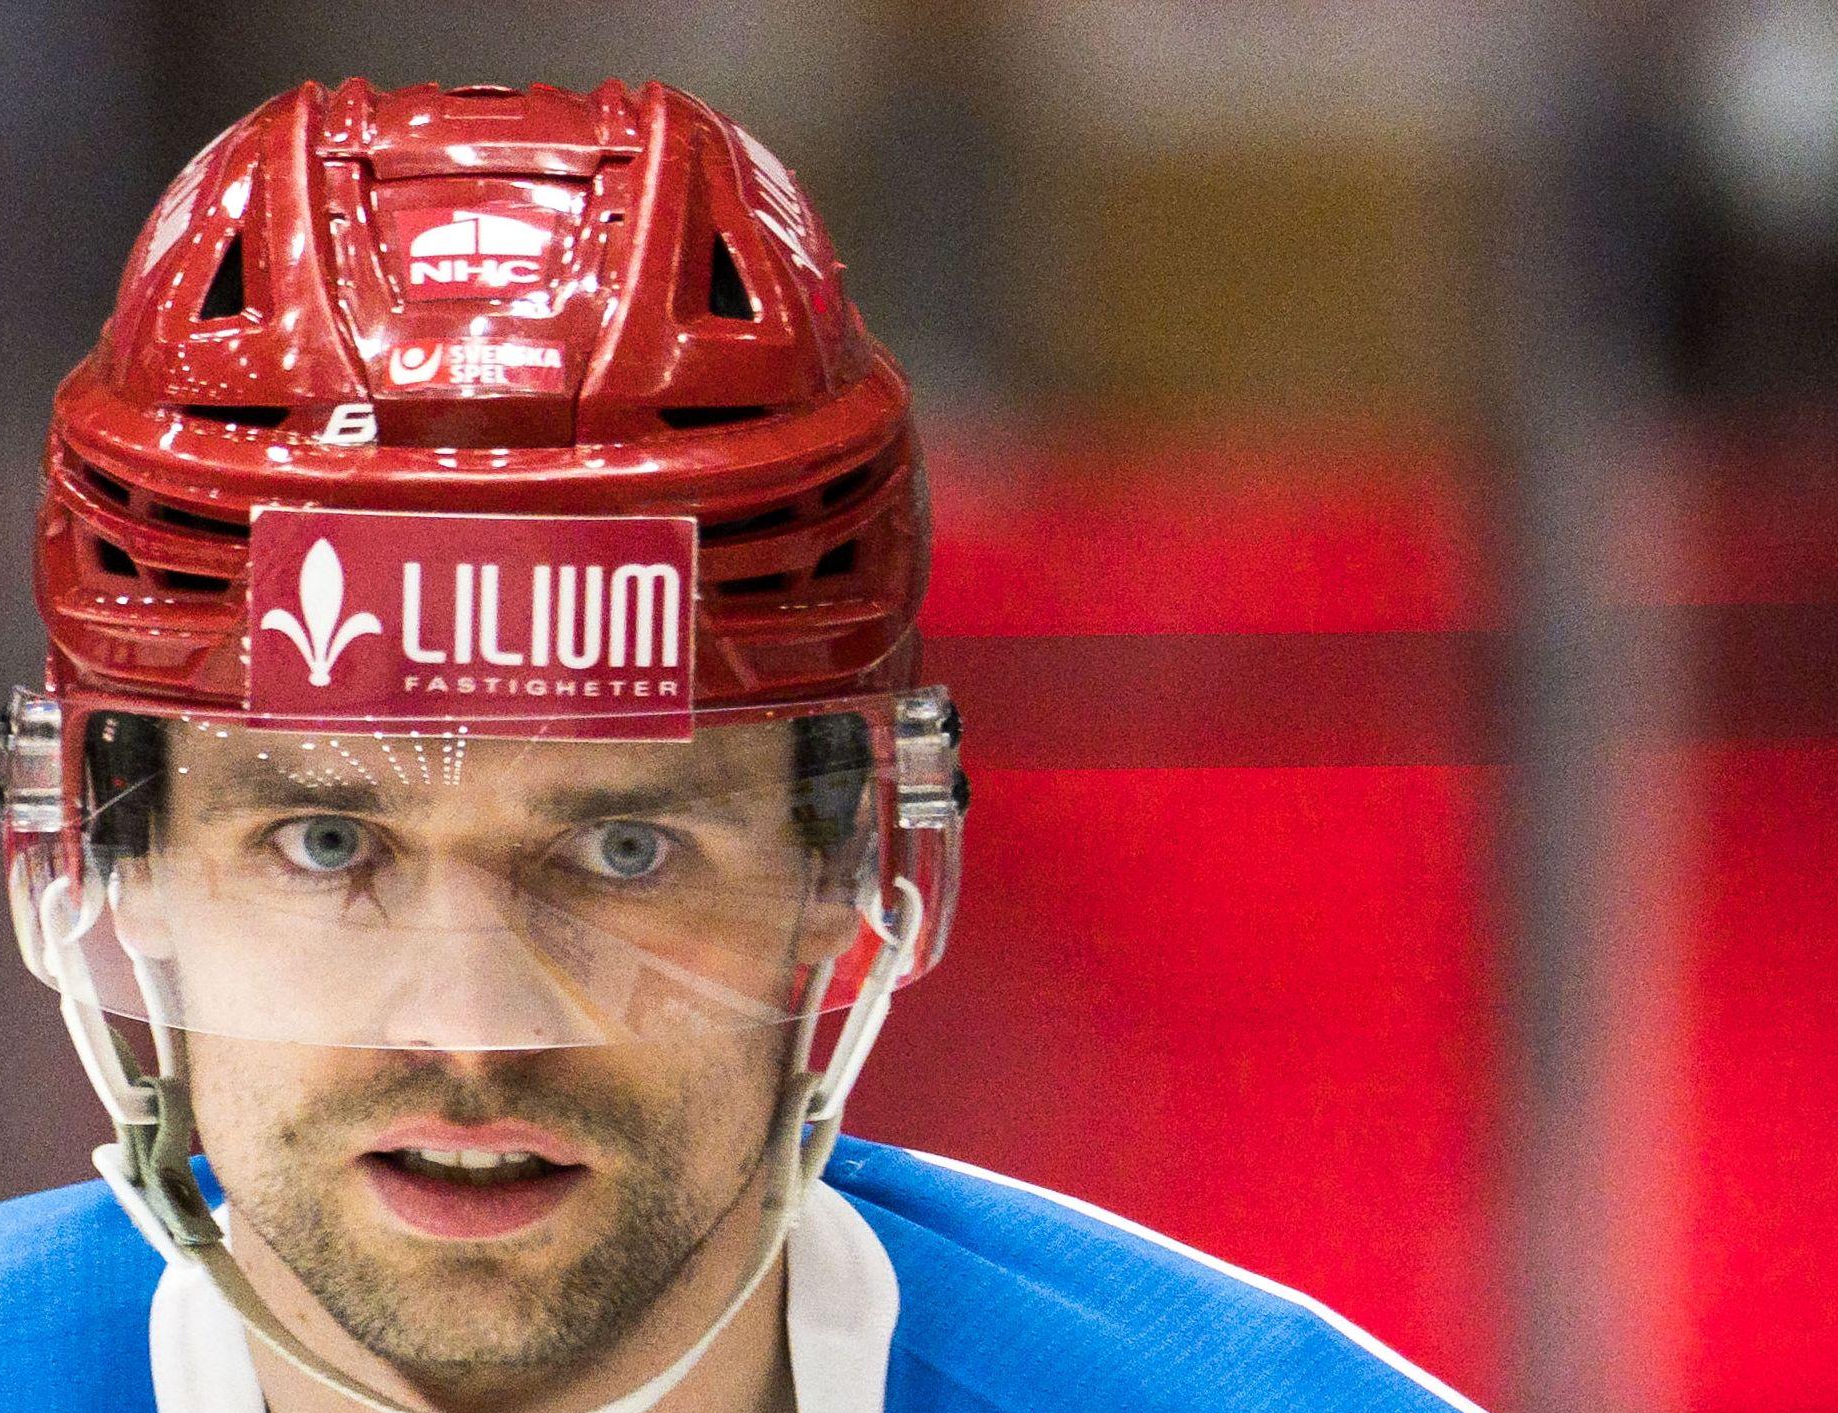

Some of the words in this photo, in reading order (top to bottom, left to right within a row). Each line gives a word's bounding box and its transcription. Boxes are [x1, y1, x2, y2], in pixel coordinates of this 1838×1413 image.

[409, 260, 541, 286] NHC
[449, 344, 563, 368] SVEKA
[449, 364, 510, 384] SPEL
[402, 562, 681, 670] LILIUM
[403, 676, 679, 697] FASTIGHETER
